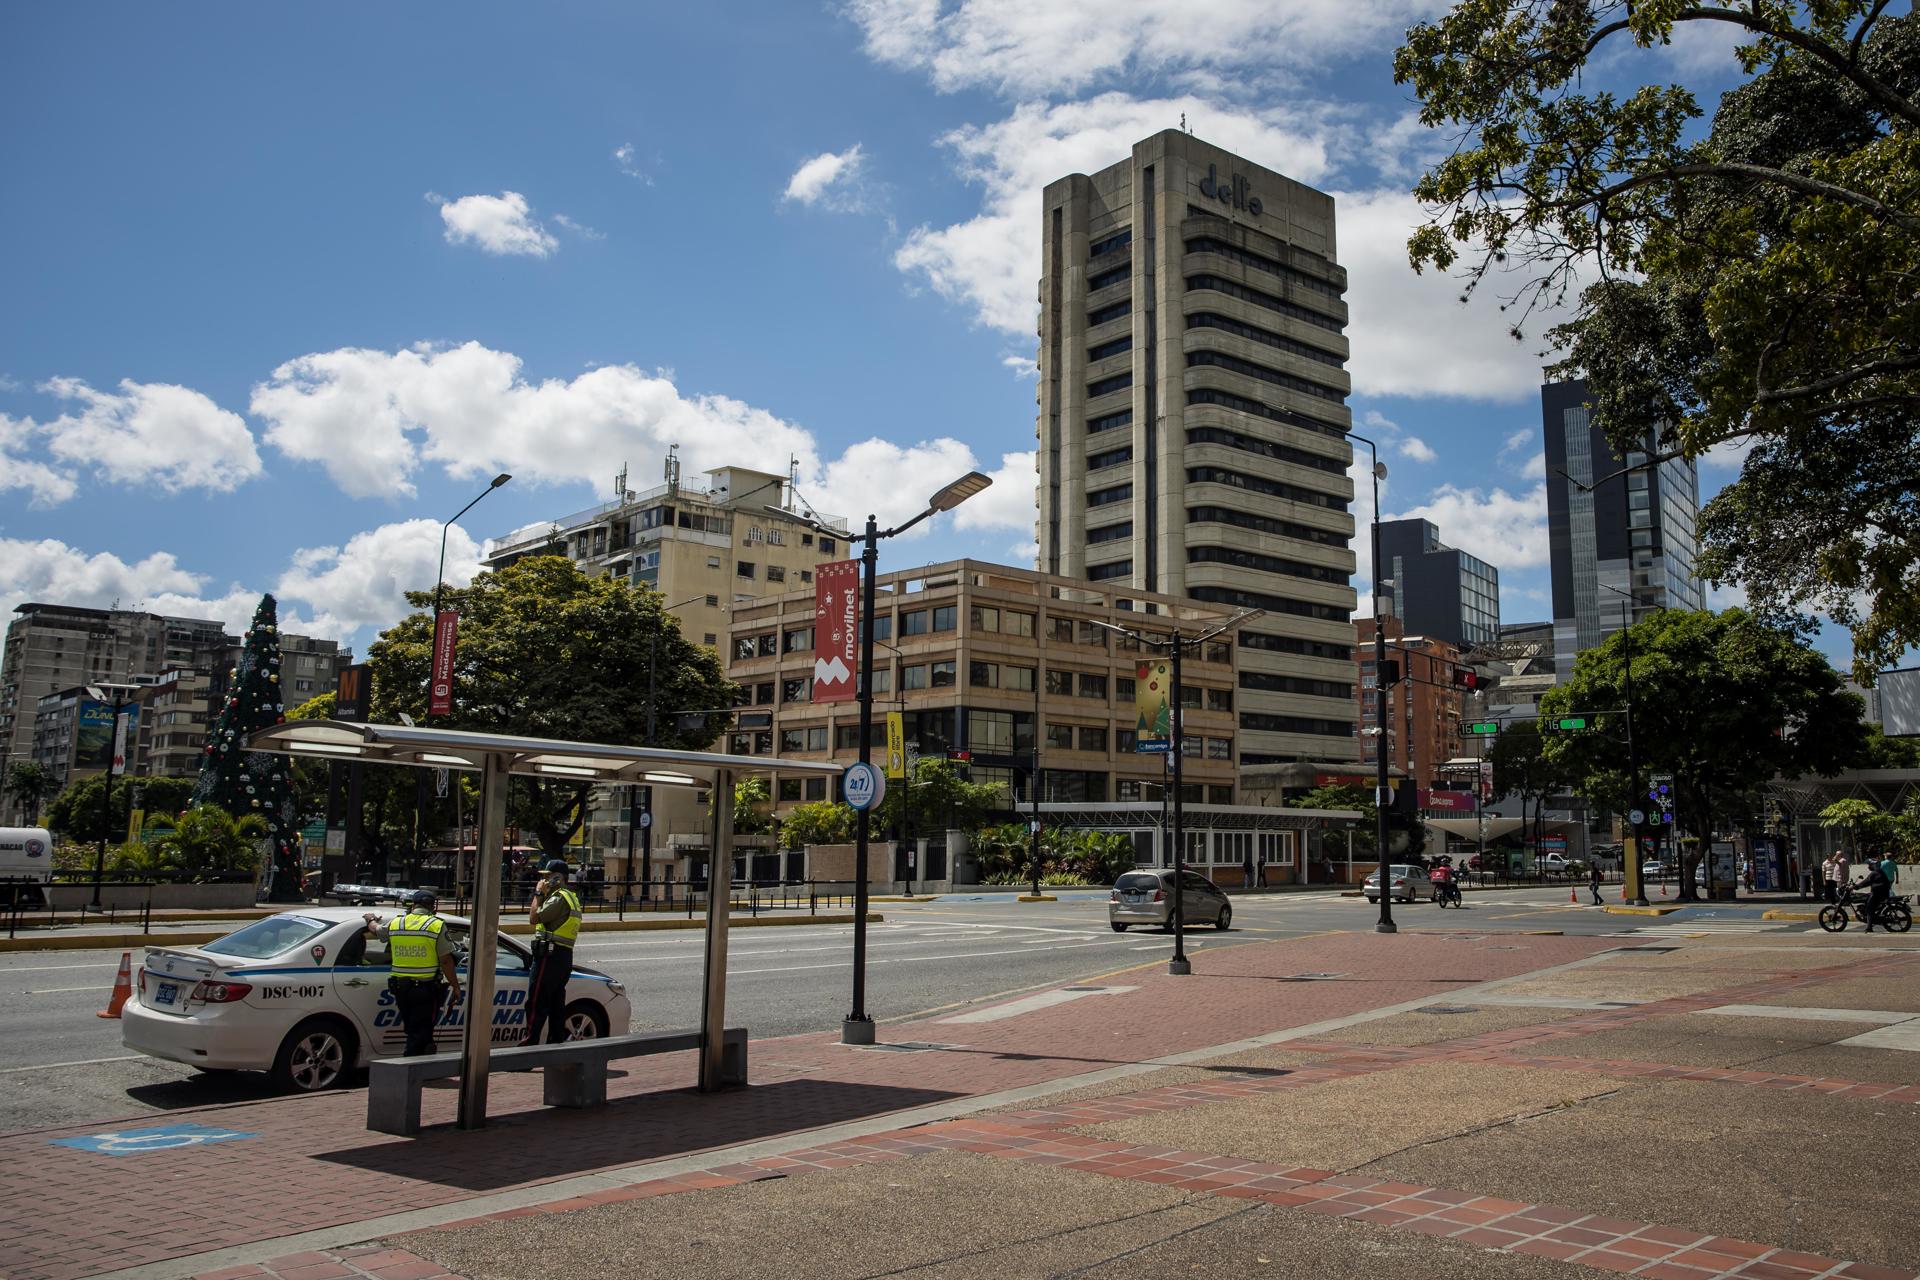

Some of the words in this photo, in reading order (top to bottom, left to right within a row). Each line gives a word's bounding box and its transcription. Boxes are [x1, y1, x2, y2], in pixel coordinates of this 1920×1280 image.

[1199, 163, 1263, 216] delta
[844, 588, 855, 660] movilnet
[442, 623, 453, 679] Madeirense
[1461, 724, 1472, 734] 16
[262, 985, 325, 999] DSC-007
